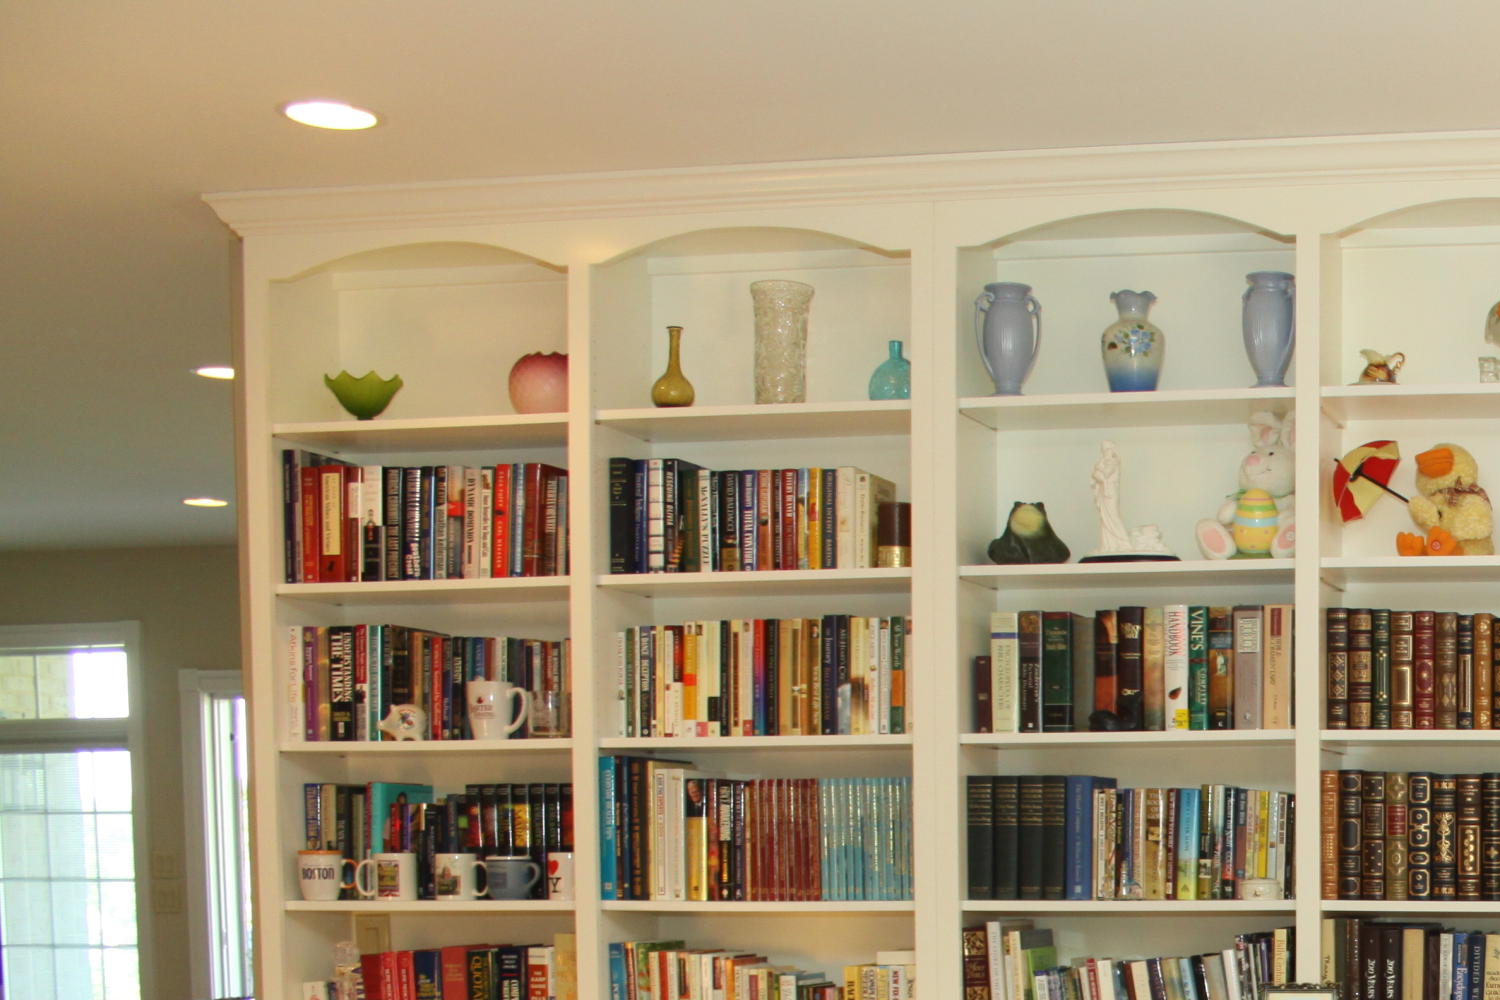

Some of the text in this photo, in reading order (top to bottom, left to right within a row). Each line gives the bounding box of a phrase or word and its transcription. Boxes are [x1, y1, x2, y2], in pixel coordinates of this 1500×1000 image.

[666, 504, 674, 526] OLIVIA
[726, 474, 735, 532] DAVID BALDACCI
[743, 510, 753, 564] TOTAL CONTROL
[824, 636, 833, 665] Journey
[1168, 611, 1186, 656] HANDBOOK
[1190, 609, 1205, 652] VINE'S
[331, 633, 344, 703] THE TIMES
[343, 632, 353, 703] UNDERSTANDING
[302, 866, 336, 882] BOSTON
[1366, 958, 1377, 999] 200 YEARS
[1384, 958, 1396, 999] 200 YEARS
[1472, 945, 1482, 984] DIVIDED
[1472, 988, 1480, 1000] WE
